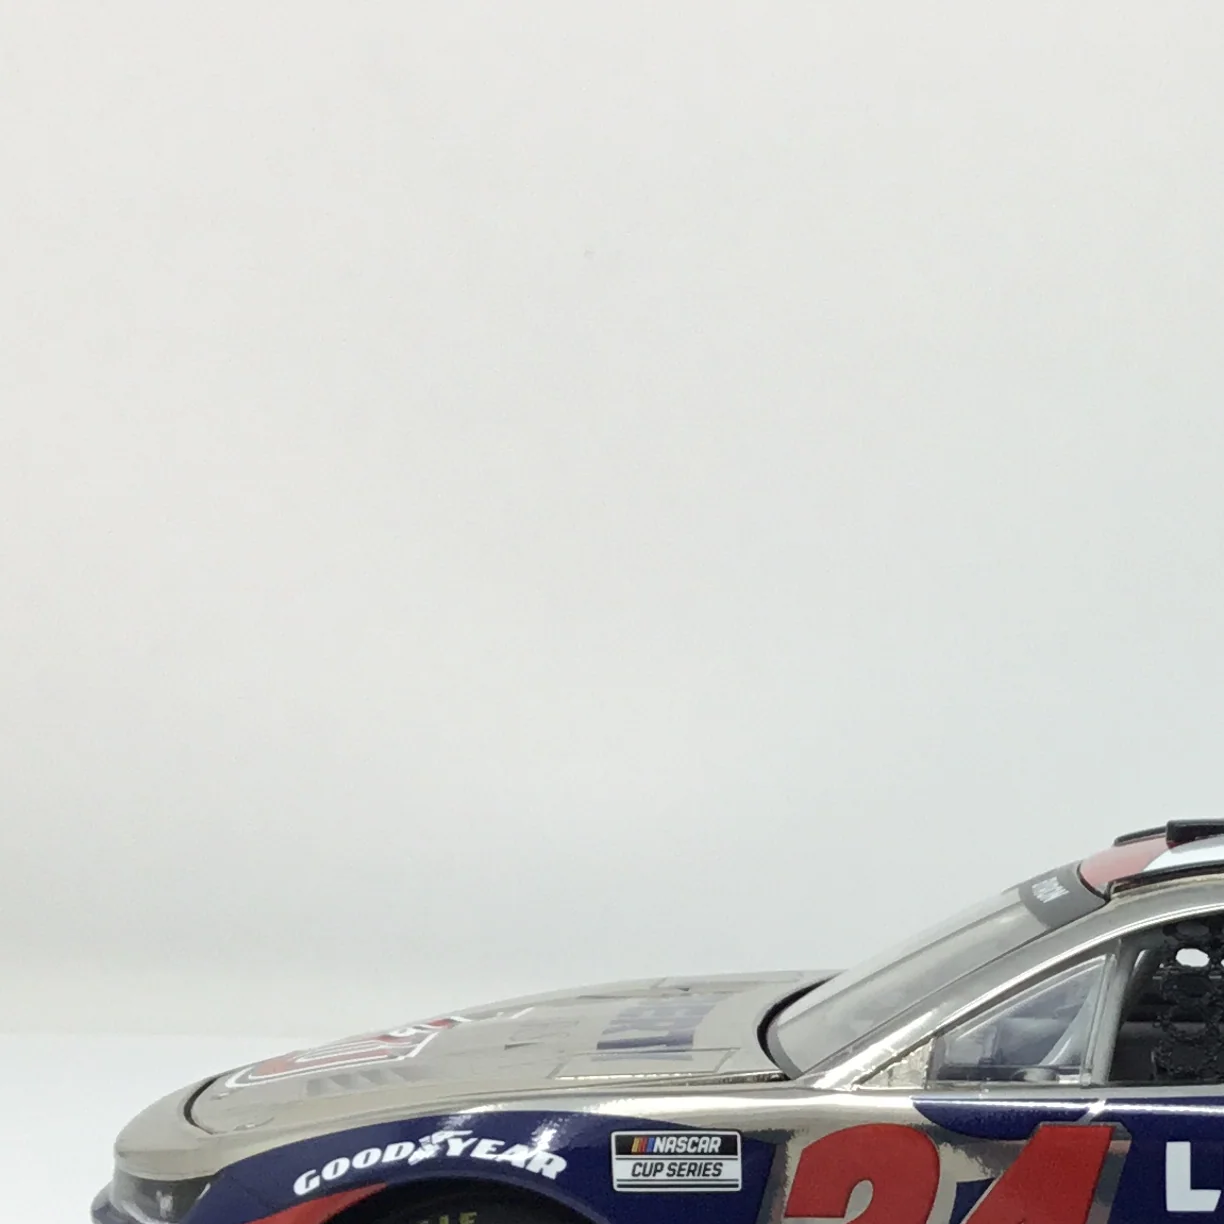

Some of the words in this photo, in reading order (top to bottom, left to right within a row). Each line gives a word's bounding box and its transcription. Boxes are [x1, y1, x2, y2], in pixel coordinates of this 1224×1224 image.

[652, 1136, 722, 1154] NASCAR
[293, 1130, 567, 1196] GOODYEAR
[631, 1162, 665, 1177] CUP
[666, 1162, 723, 1177] SERIES
